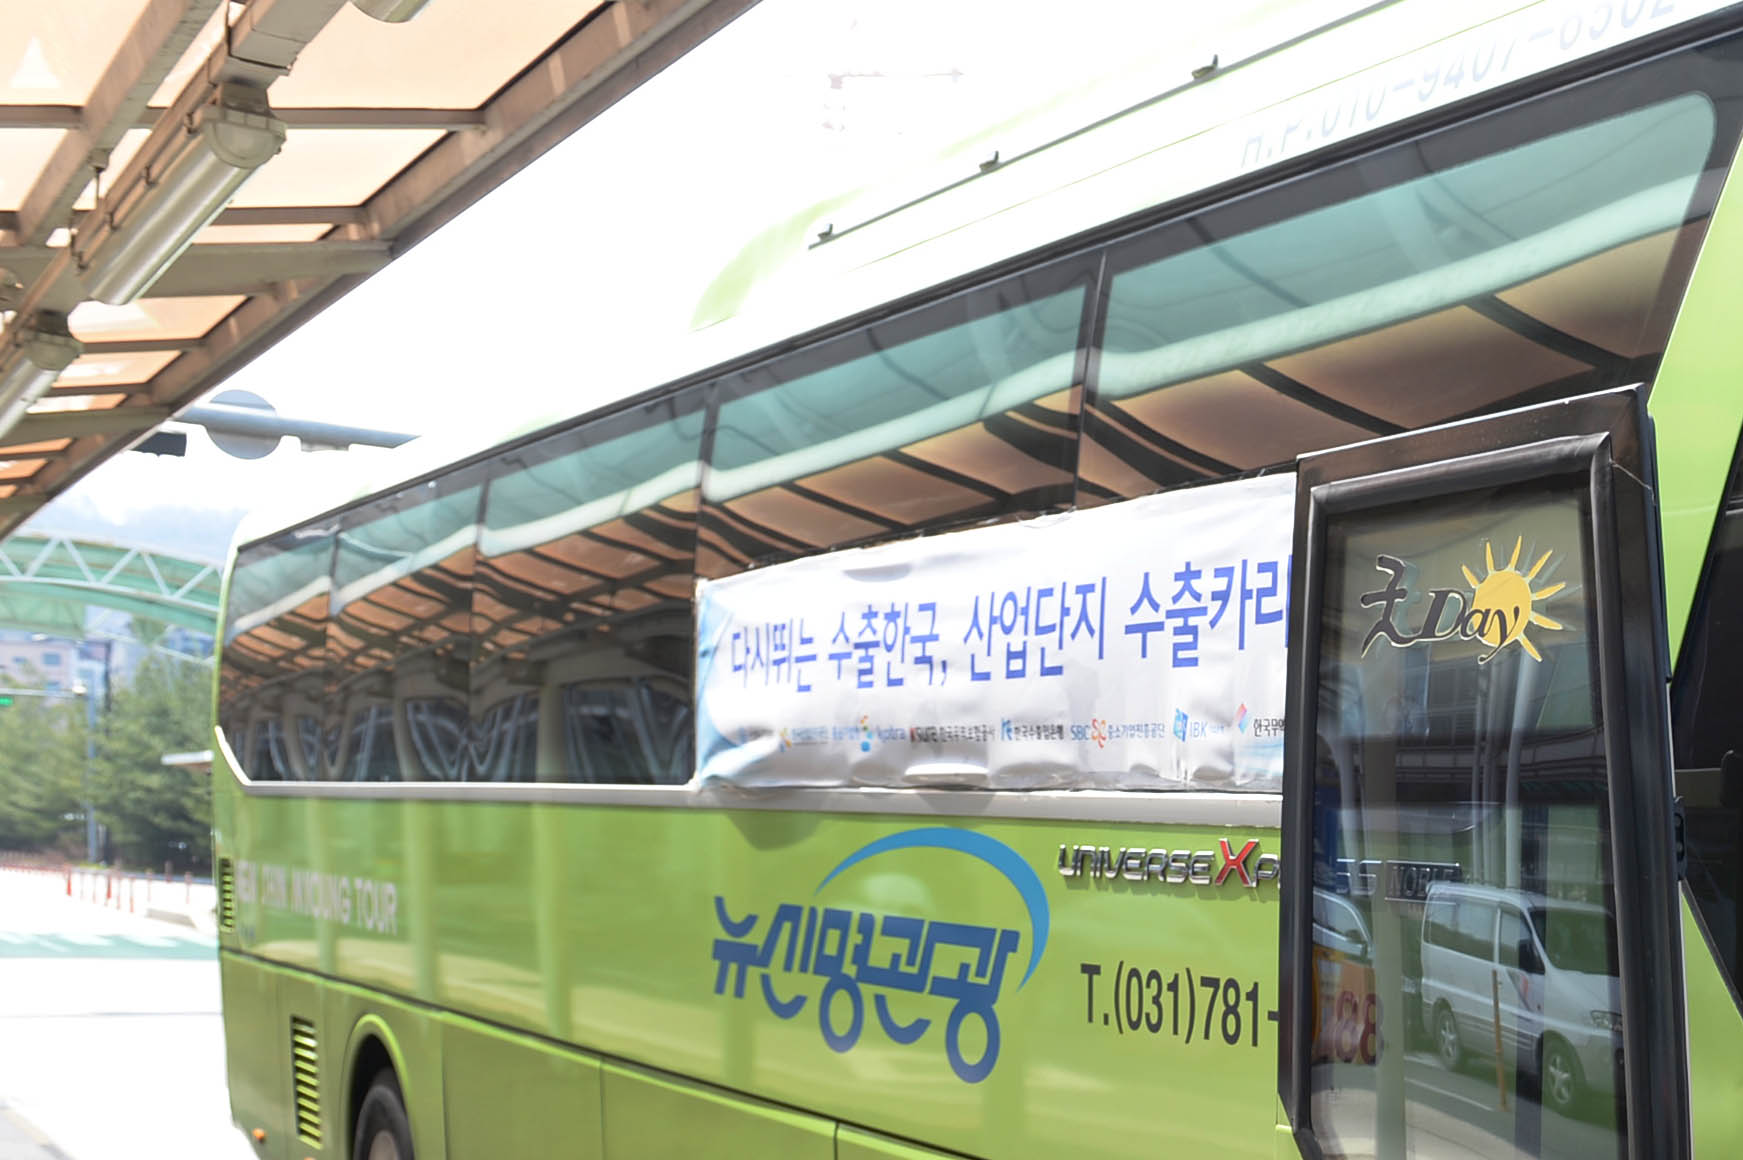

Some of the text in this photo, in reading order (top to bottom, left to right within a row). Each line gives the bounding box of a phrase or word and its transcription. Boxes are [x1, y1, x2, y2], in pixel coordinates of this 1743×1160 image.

[732, 618, 817, 692] 다시뛰는
[828, 602, 948, 689] 수출한국,
[963, 576, 1106, 681] 산업단지
[1189, 720, 1207, 738] IBK
[713, 896, 1021, 1084] 뉴신명관광
